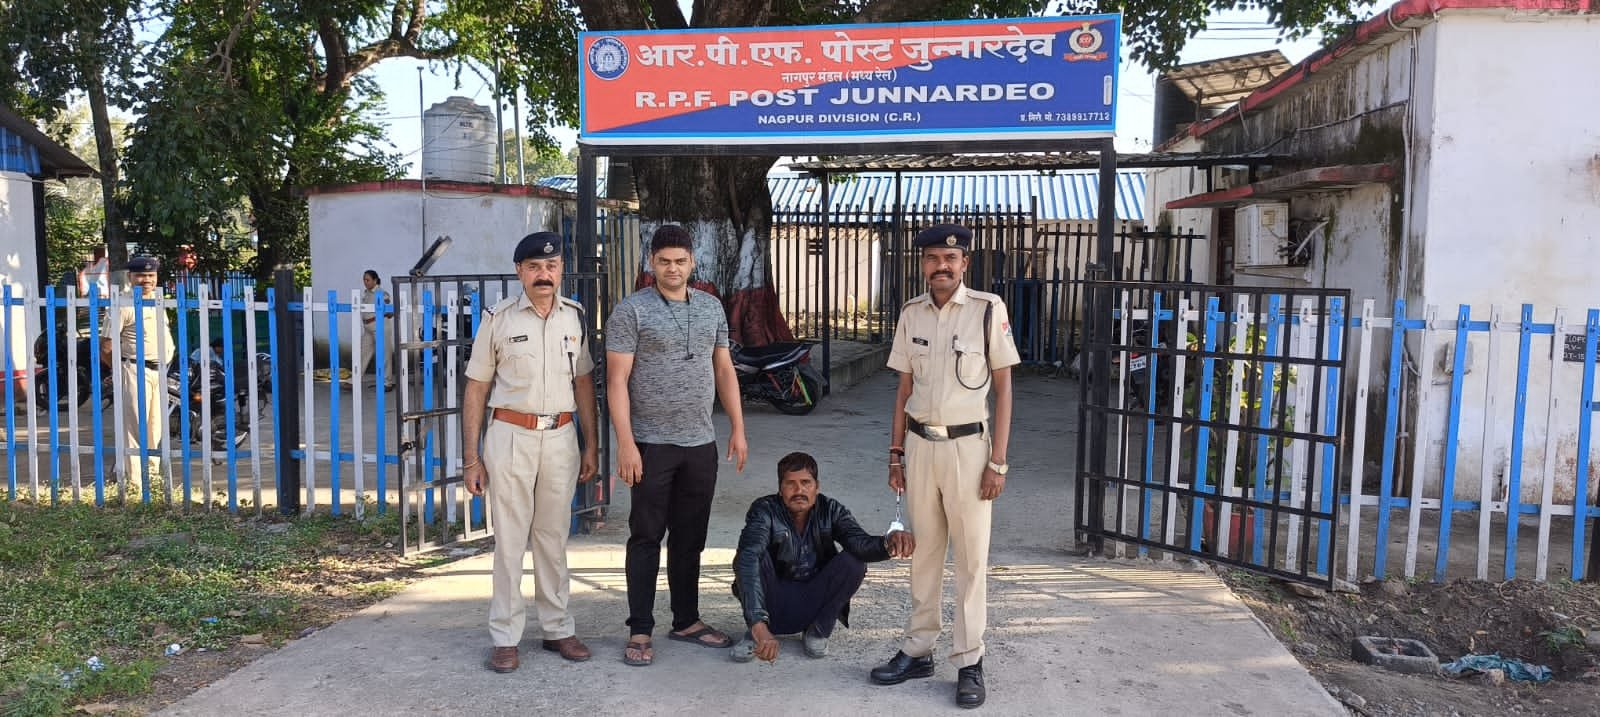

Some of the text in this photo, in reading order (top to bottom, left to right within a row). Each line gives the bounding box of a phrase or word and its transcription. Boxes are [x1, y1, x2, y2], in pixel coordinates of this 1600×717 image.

[635, 36, 812, 67] आर.पी.एफ.
[821, 31, 893, 63] पोस्ट
[901, 26, 1056, 72] जुन्नारदेव
[781, 68, 898, 87] नागपुर मंडल (मध्य रेल)
[634, 83, 1056, 109] R.P.F. POST JUNNARDEO
[758, 112, 921, 124] NAGPUR DIVISION (C.R.)
